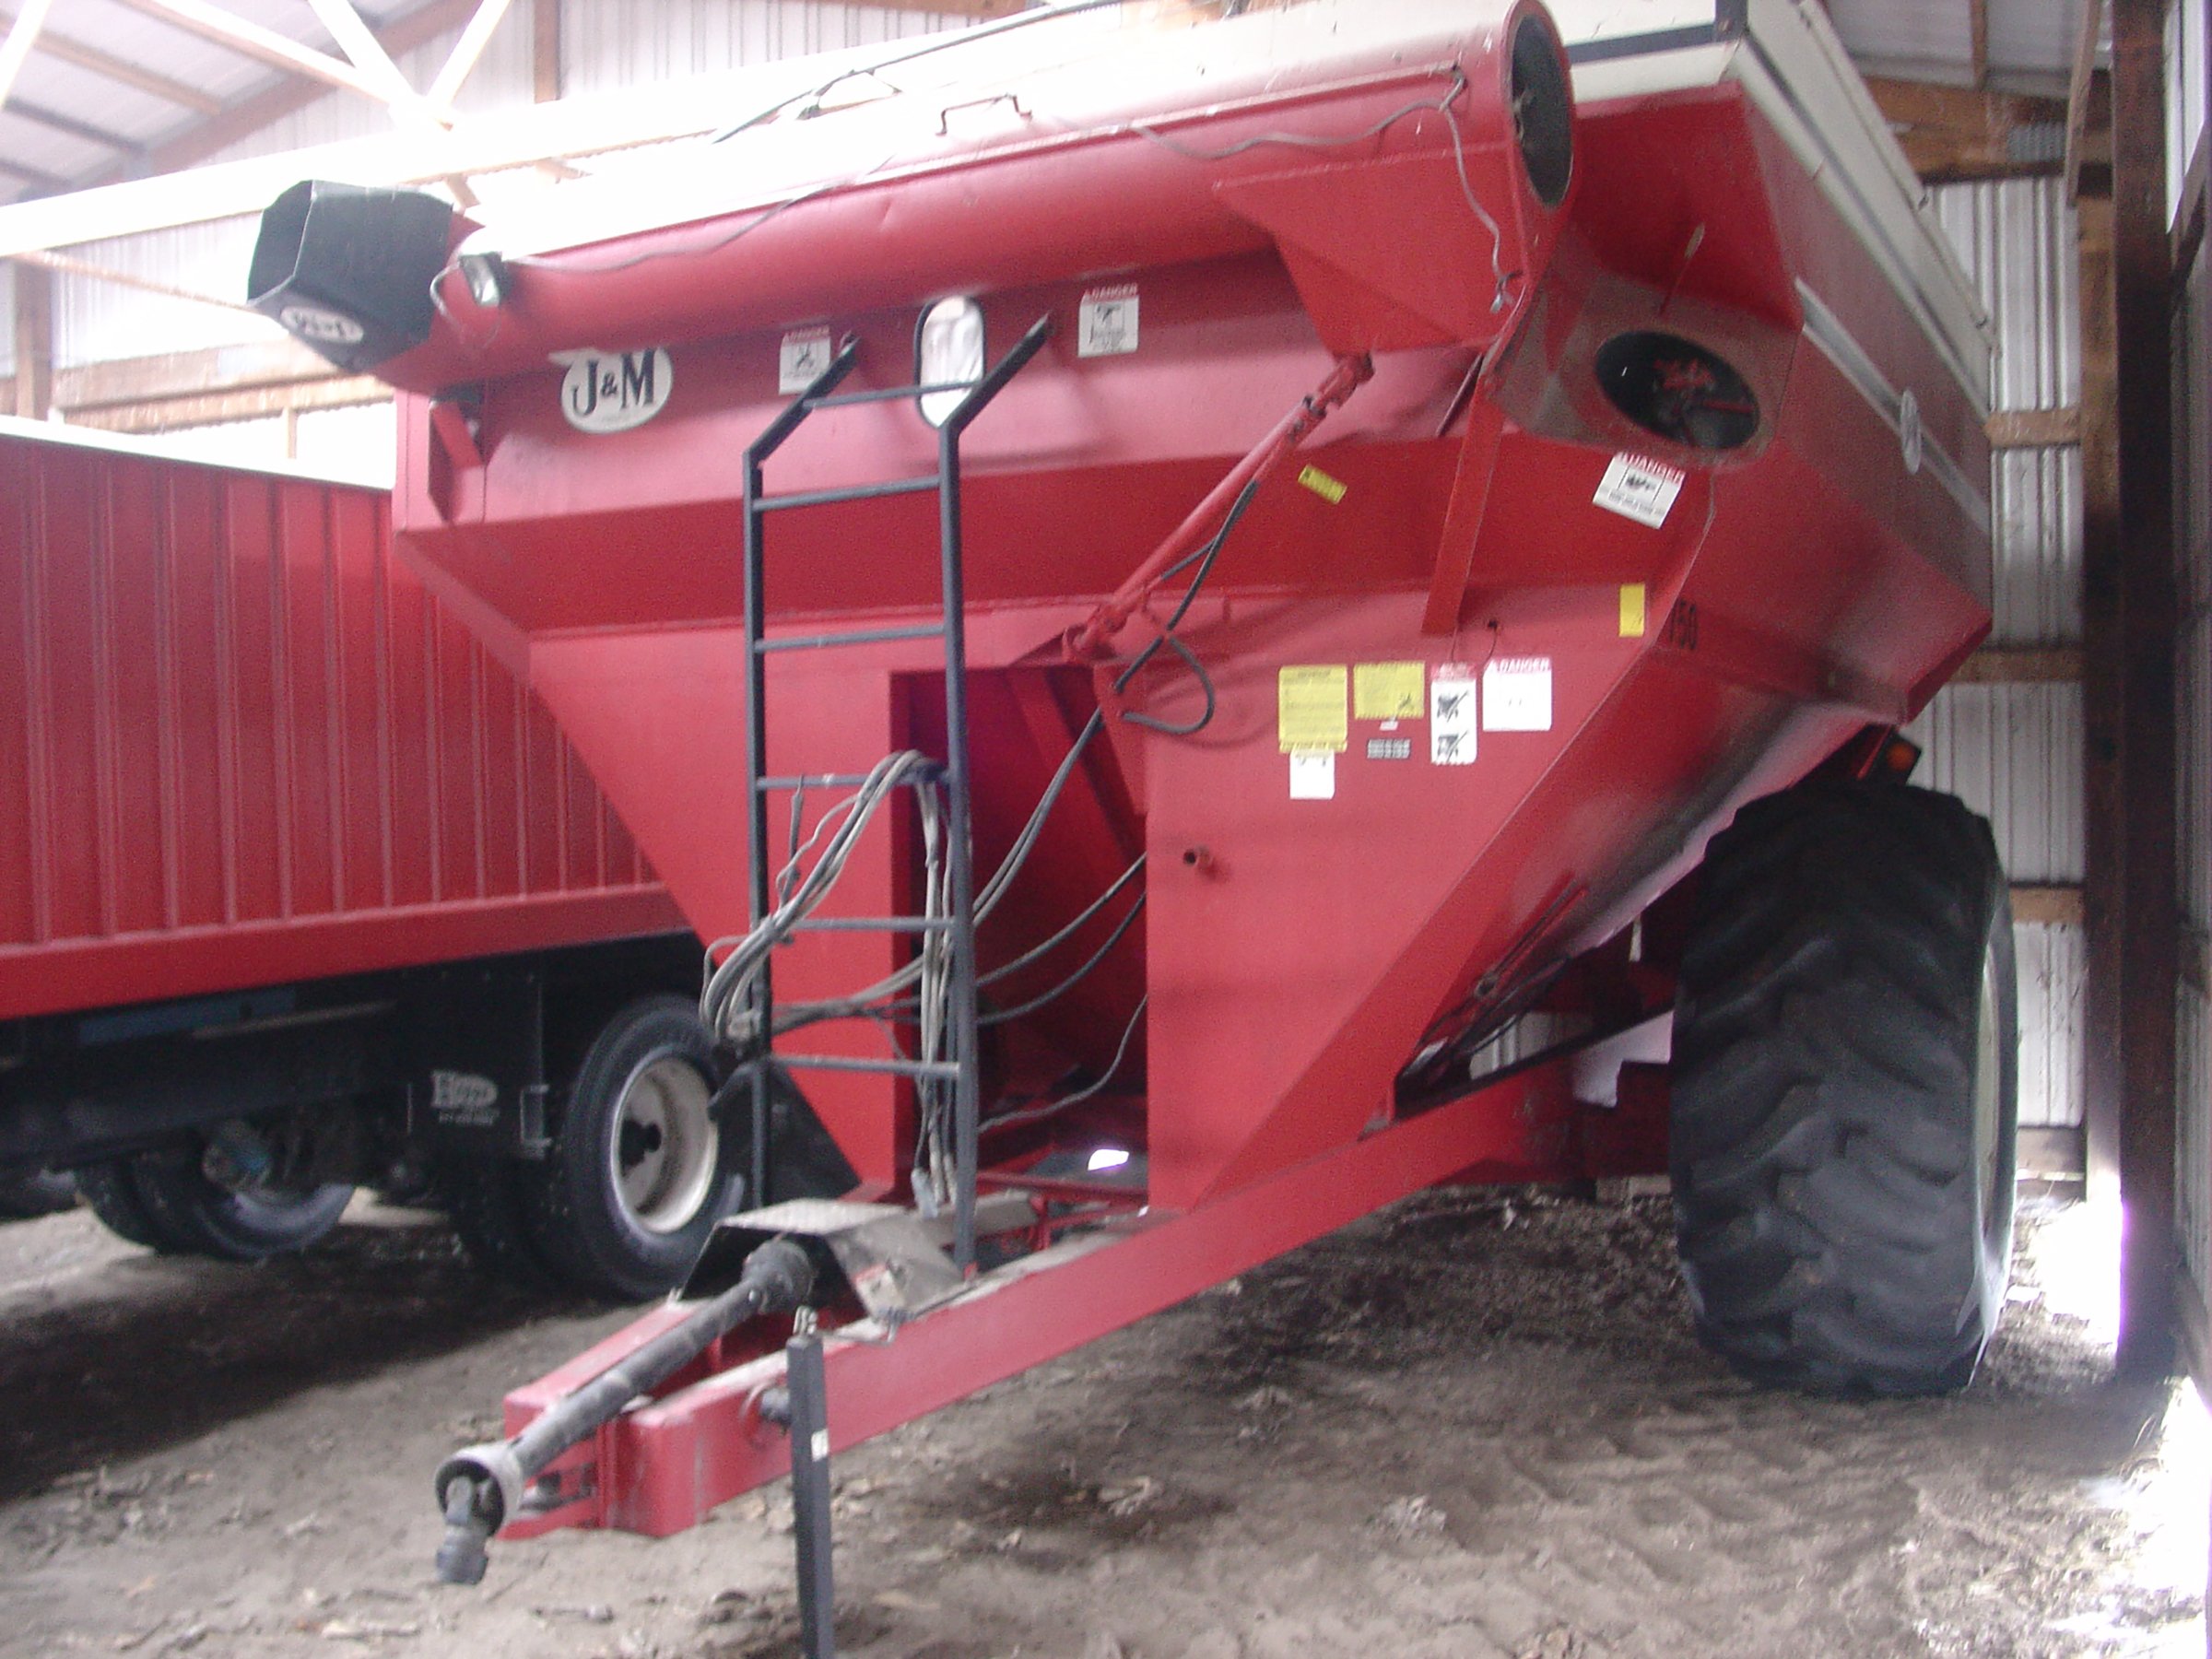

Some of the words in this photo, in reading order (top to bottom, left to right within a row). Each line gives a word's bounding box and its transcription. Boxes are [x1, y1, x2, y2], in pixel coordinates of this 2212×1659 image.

[571, 347, 655, 415] J&M
[1626, 453, 1686, 486] DANGER
[1499, 656, 1551, 674] DANGER
